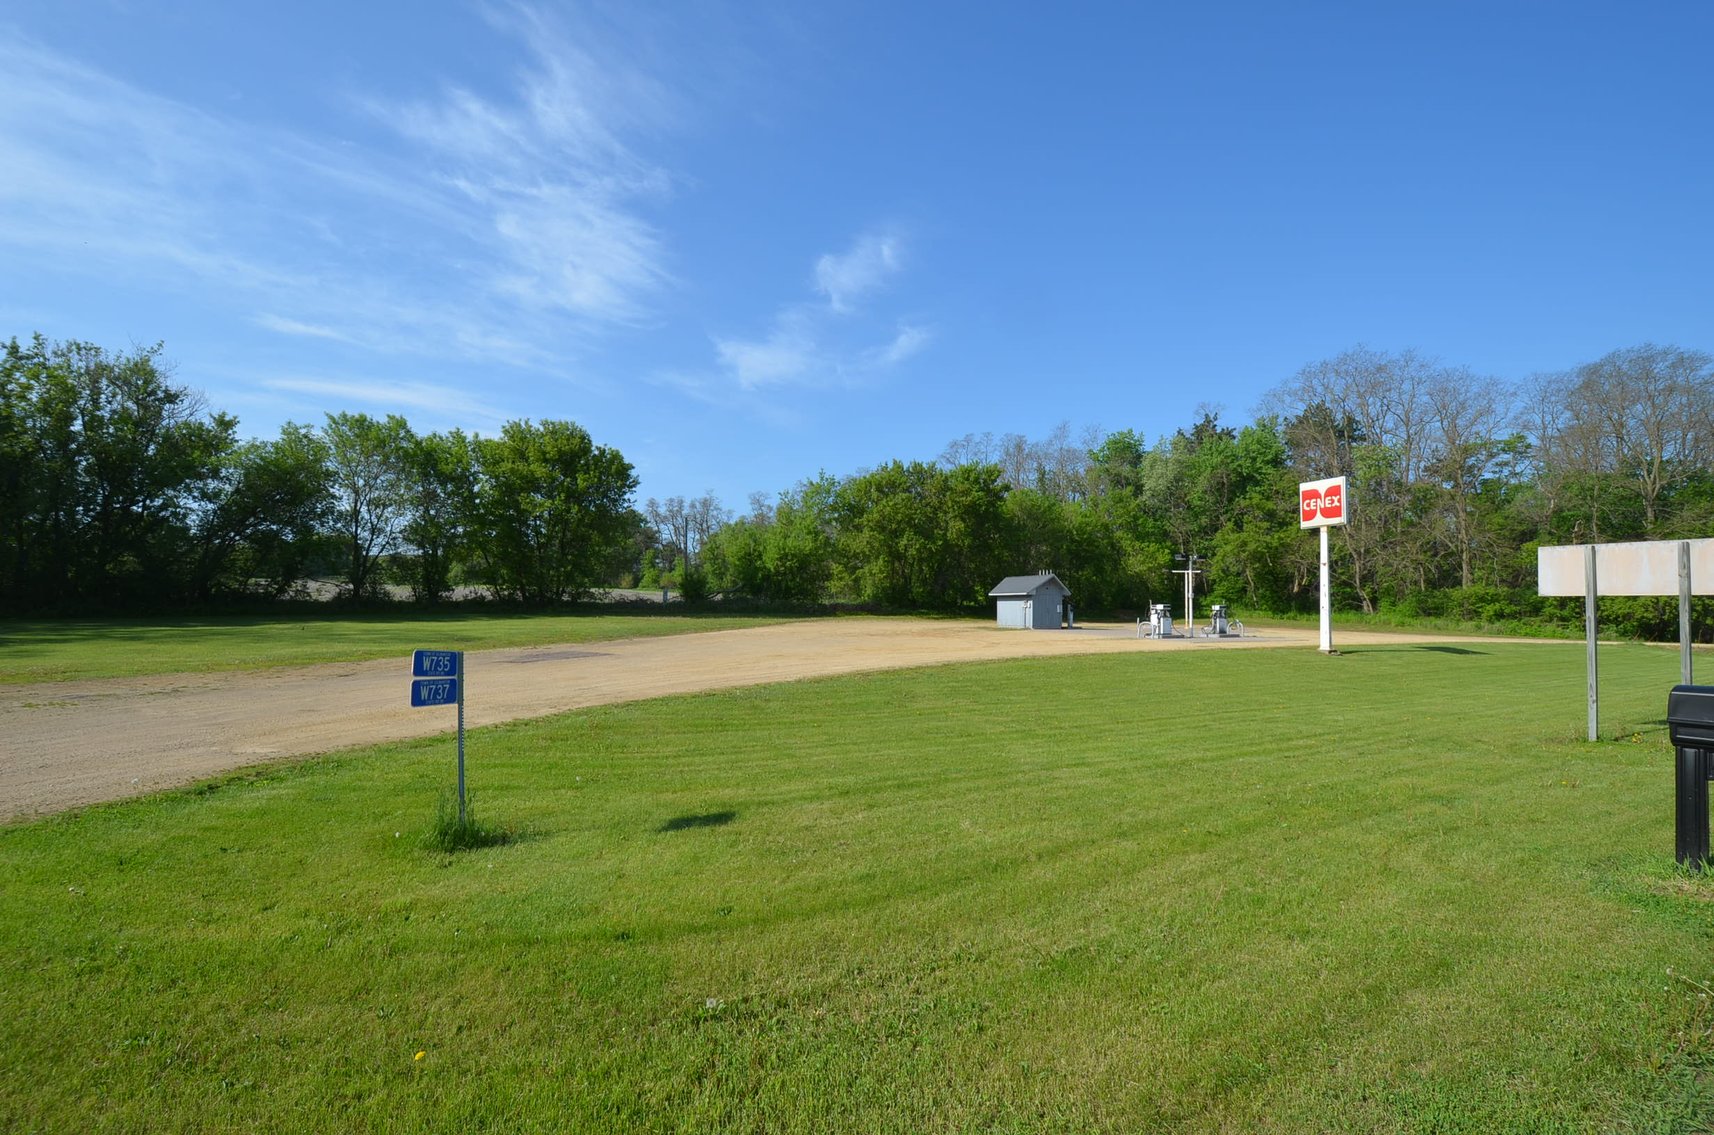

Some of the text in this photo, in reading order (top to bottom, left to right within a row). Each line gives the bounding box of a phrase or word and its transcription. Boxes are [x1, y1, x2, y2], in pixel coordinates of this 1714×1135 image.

[1303, 495, 1340, 510] CENEX
[423, 656, 450, 671] W735
[420, 685, 450, 700] W737
